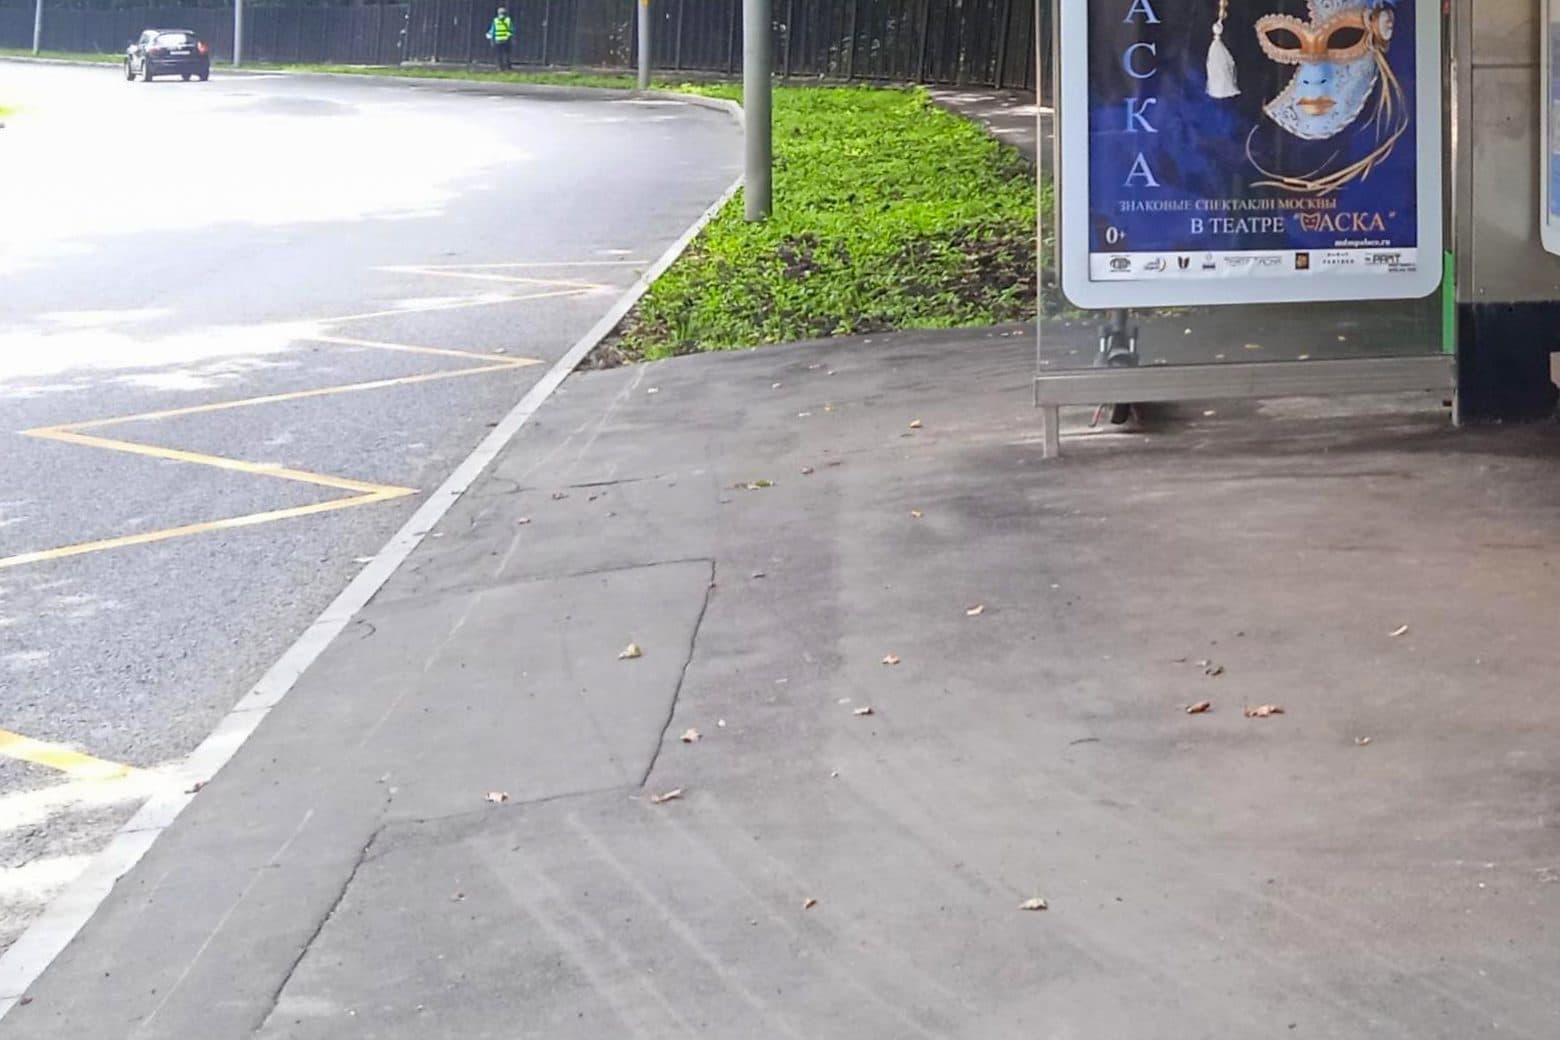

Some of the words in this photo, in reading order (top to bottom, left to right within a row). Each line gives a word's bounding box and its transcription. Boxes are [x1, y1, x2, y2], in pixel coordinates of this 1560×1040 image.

[1119, 199, 1192, 212] ЗНАКОВЫЕ
[1195, 199, 1275, 211] СПЕКТАКЛИ
[1278, 198, 1337, 210] МОСКВЫ
[1191, 217, 1204, 234] В
[1208, 216, 1285, 234] ТЕАТРЕ
